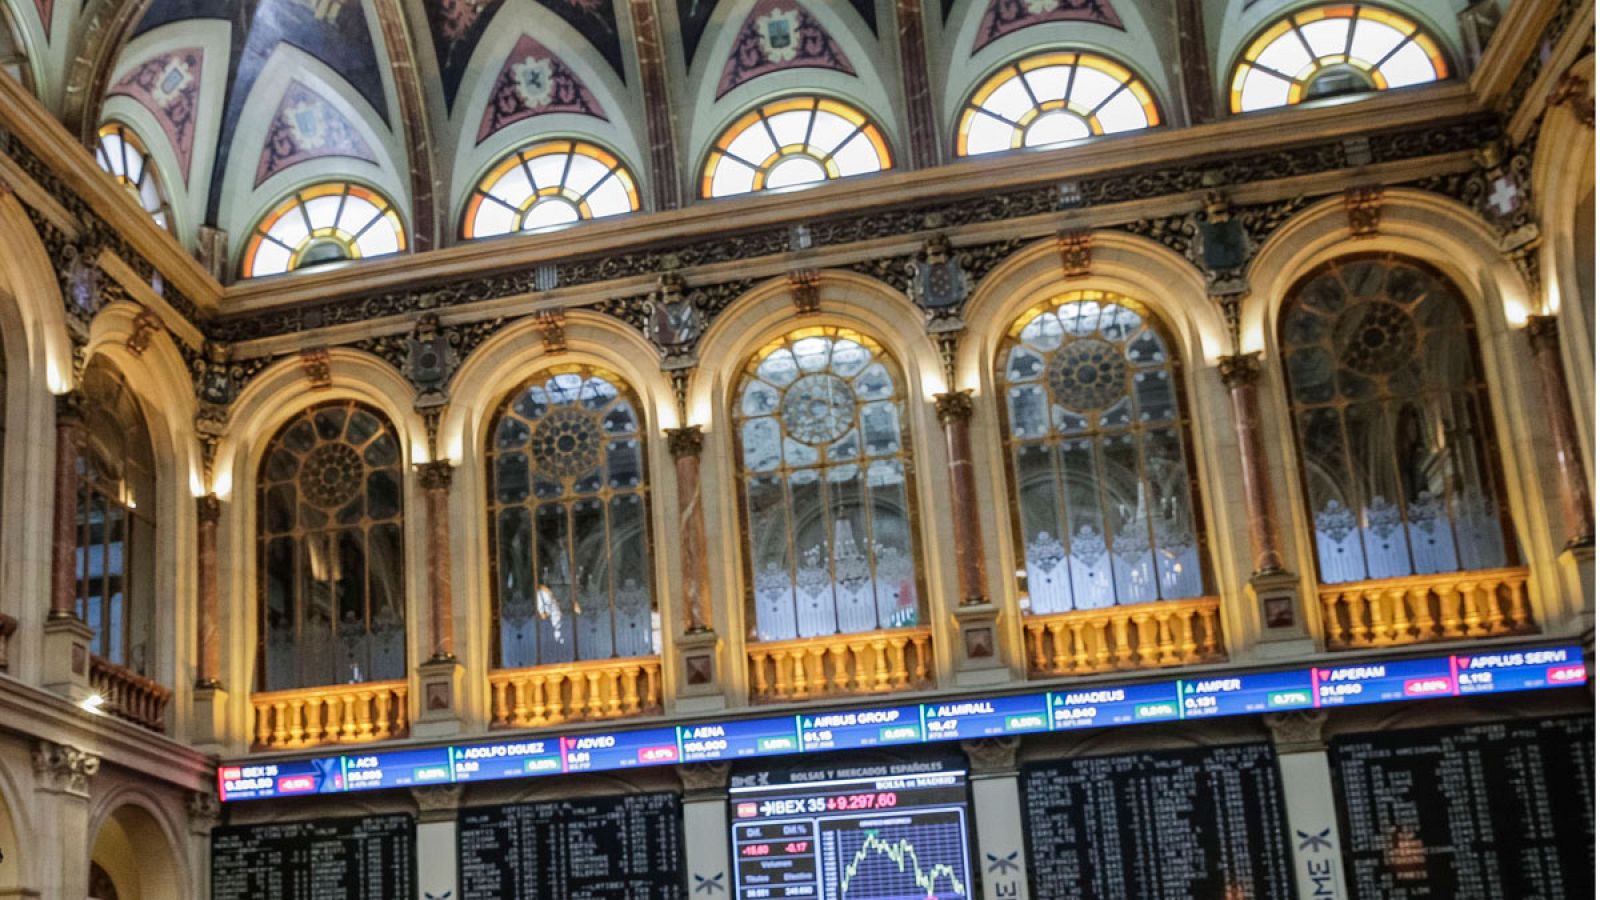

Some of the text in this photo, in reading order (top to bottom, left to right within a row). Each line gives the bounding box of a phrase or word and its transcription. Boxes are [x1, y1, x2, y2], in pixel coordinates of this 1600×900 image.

[1470, 650, 1567, 669] APPLUS SERVI
[1330, 665, 1386, 681] APERAM
[1196, 679, 1241, 693] AMPER
[1065, 689, 1125, 705] AMADEUS
[937, 702, 995, 717] ALMIRALL
[814, 710, 900, 728] AIRBUS GROUP
[692, 726, 725, 738] AENA
[465, 742, 545, 759] ADOLFO DGUEZ
[576, 736, 616, 749] ADVEO
[356, 756, 379, 768] ACS
[790, 772, 825, 782] BOLSAS
[836, 766, 888, 778] MERCADOS
[890, 761, 944, 774] ESPAÑOLES
[875, 780, 906, 790] BOLSA
[916, 776, 956, 787] MADRID
[770, 792, 897, 814] IBEX 35 9.297,60
[1307, 859, 1334, 900] ME
